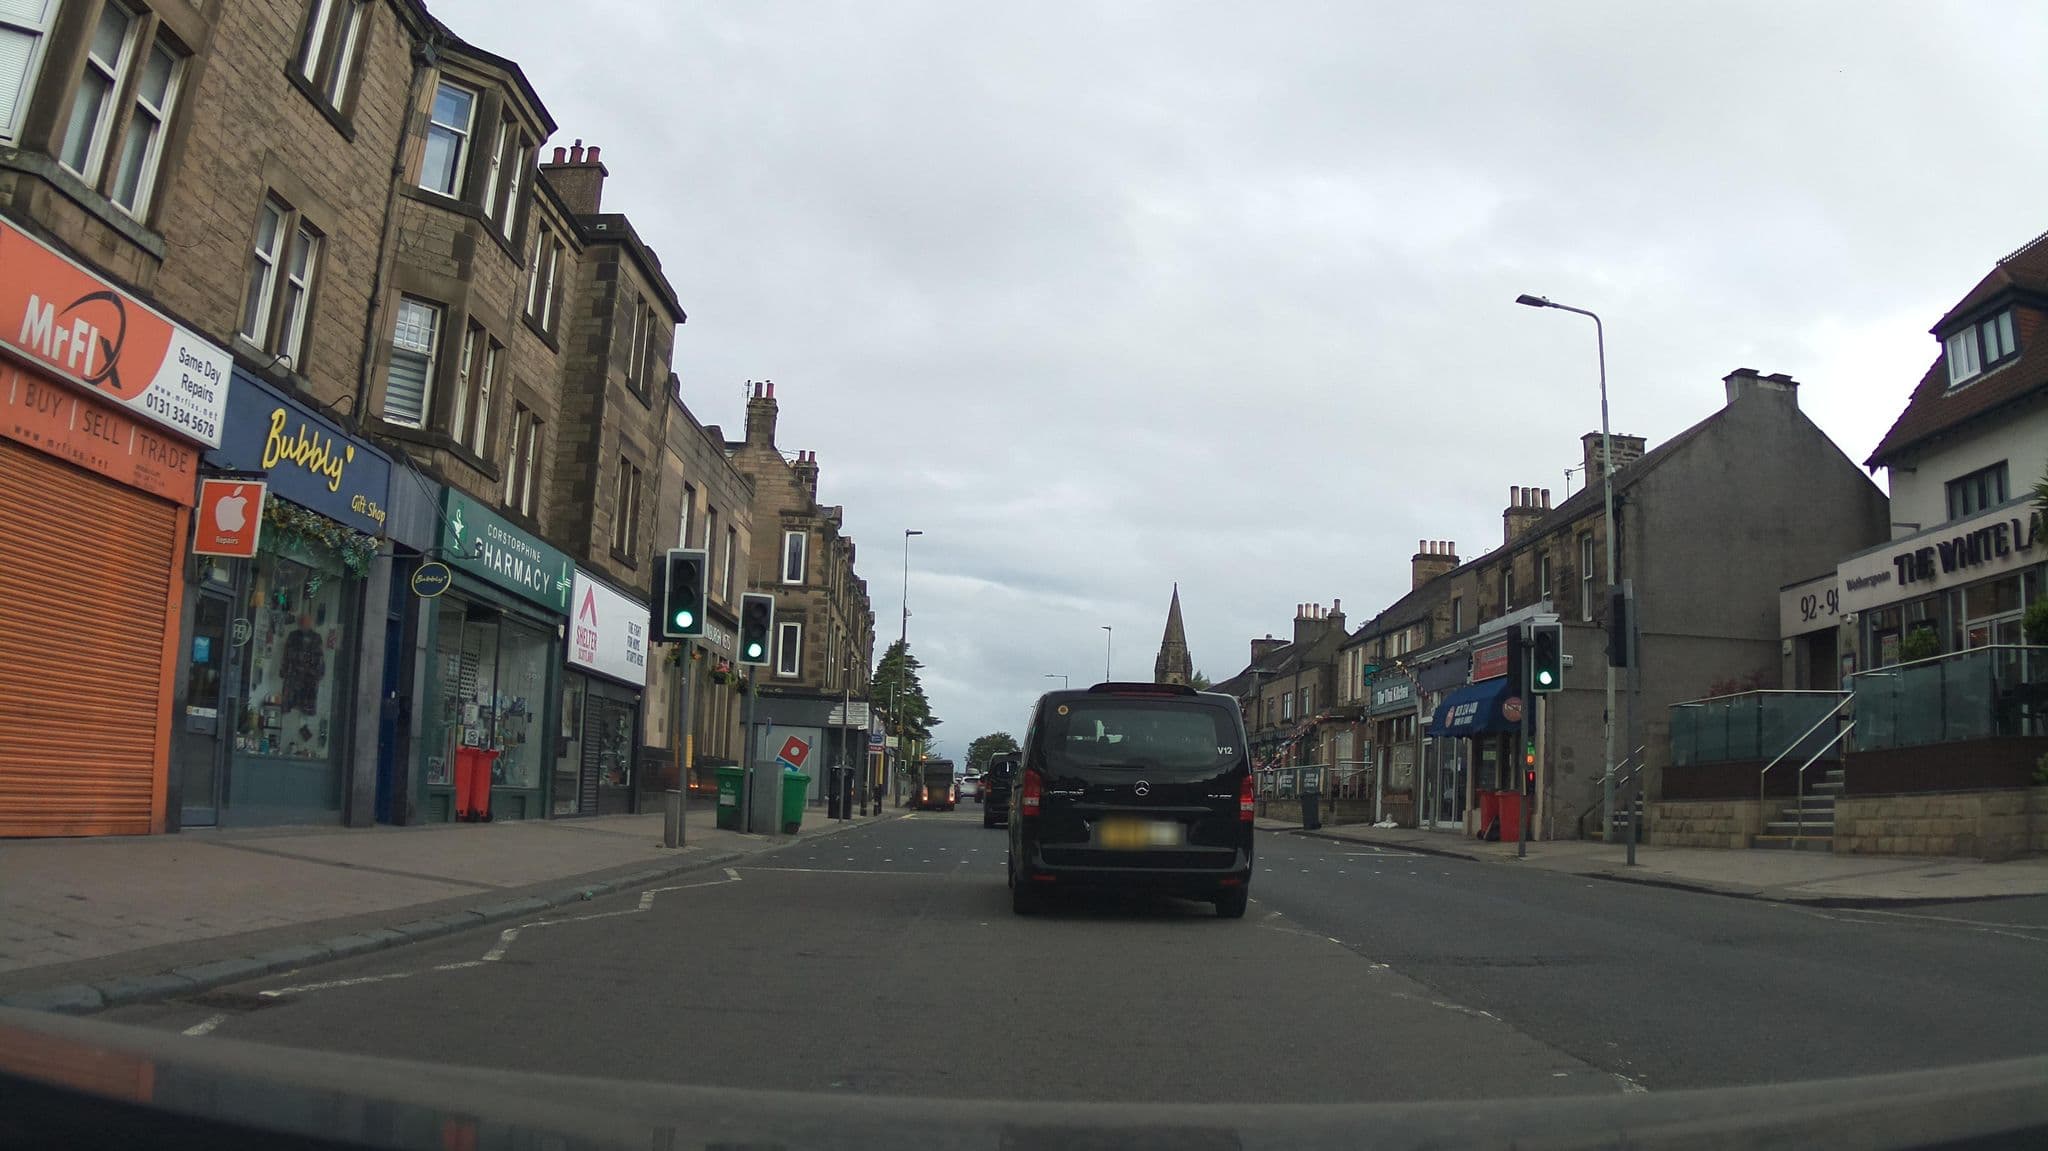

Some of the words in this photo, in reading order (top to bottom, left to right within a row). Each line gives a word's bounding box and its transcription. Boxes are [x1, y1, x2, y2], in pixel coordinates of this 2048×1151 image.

[179, 347, 203, 373] Same
[204, 361, 221, 386] Day
[181, 373, 214, 403] Repairs
[25, 383, 62, 417] BUY
[83, 409, 119, 445] SELL
[140, 434, 189, 474] TRADE
[146, 393, 170, 417] 0131
[172, 406, 190, 426] 334
[191, 416, 214, 438] 5678
[262, 408, 343, 492] Bubbly
[351, 495, 367, 514] Gift
[367, 502, 386, 528] Shop
[215, 535, 240, 546] Repairs
[487, 523, 541, 563] CORSTORPHINE
[1894, 546, 1936, 586] THE
[1936, 522, 2010, 574] WHITE
[576, 624, 598, 651] SHELTER
[1217, 746, 1232, 754] V12
